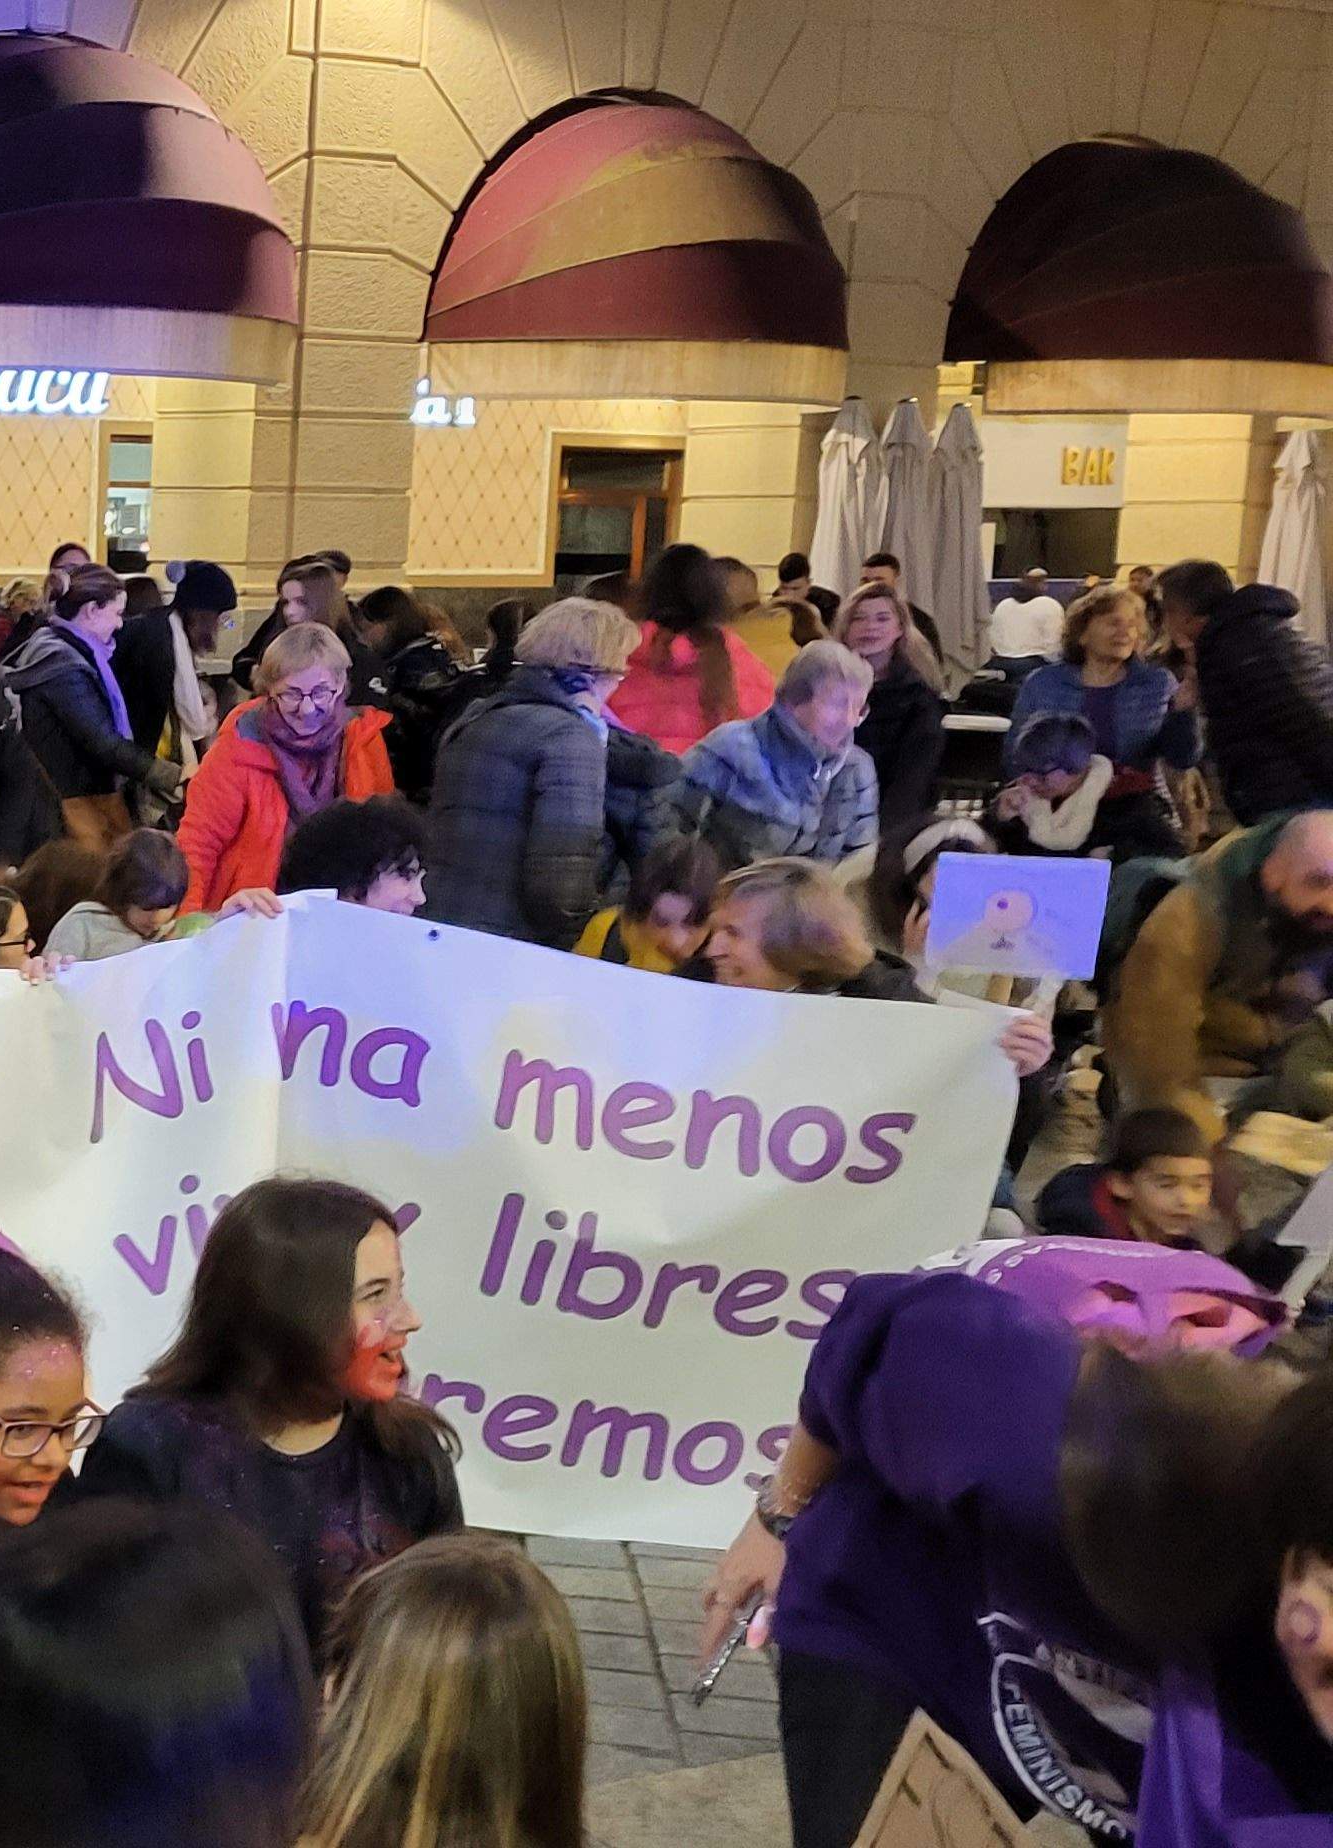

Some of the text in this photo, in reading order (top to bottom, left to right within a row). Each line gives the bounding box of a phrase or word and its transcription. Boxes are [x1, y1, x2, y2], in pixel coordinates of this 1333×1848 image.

[1061, 446, 1116, 487] BAR
[90, 1010, 215, 1144] Ni
[495, 1048, 918, 1185] menos
[479, 1192, 853, 1342] libres
[421, 1373, 792, 1488] remos
